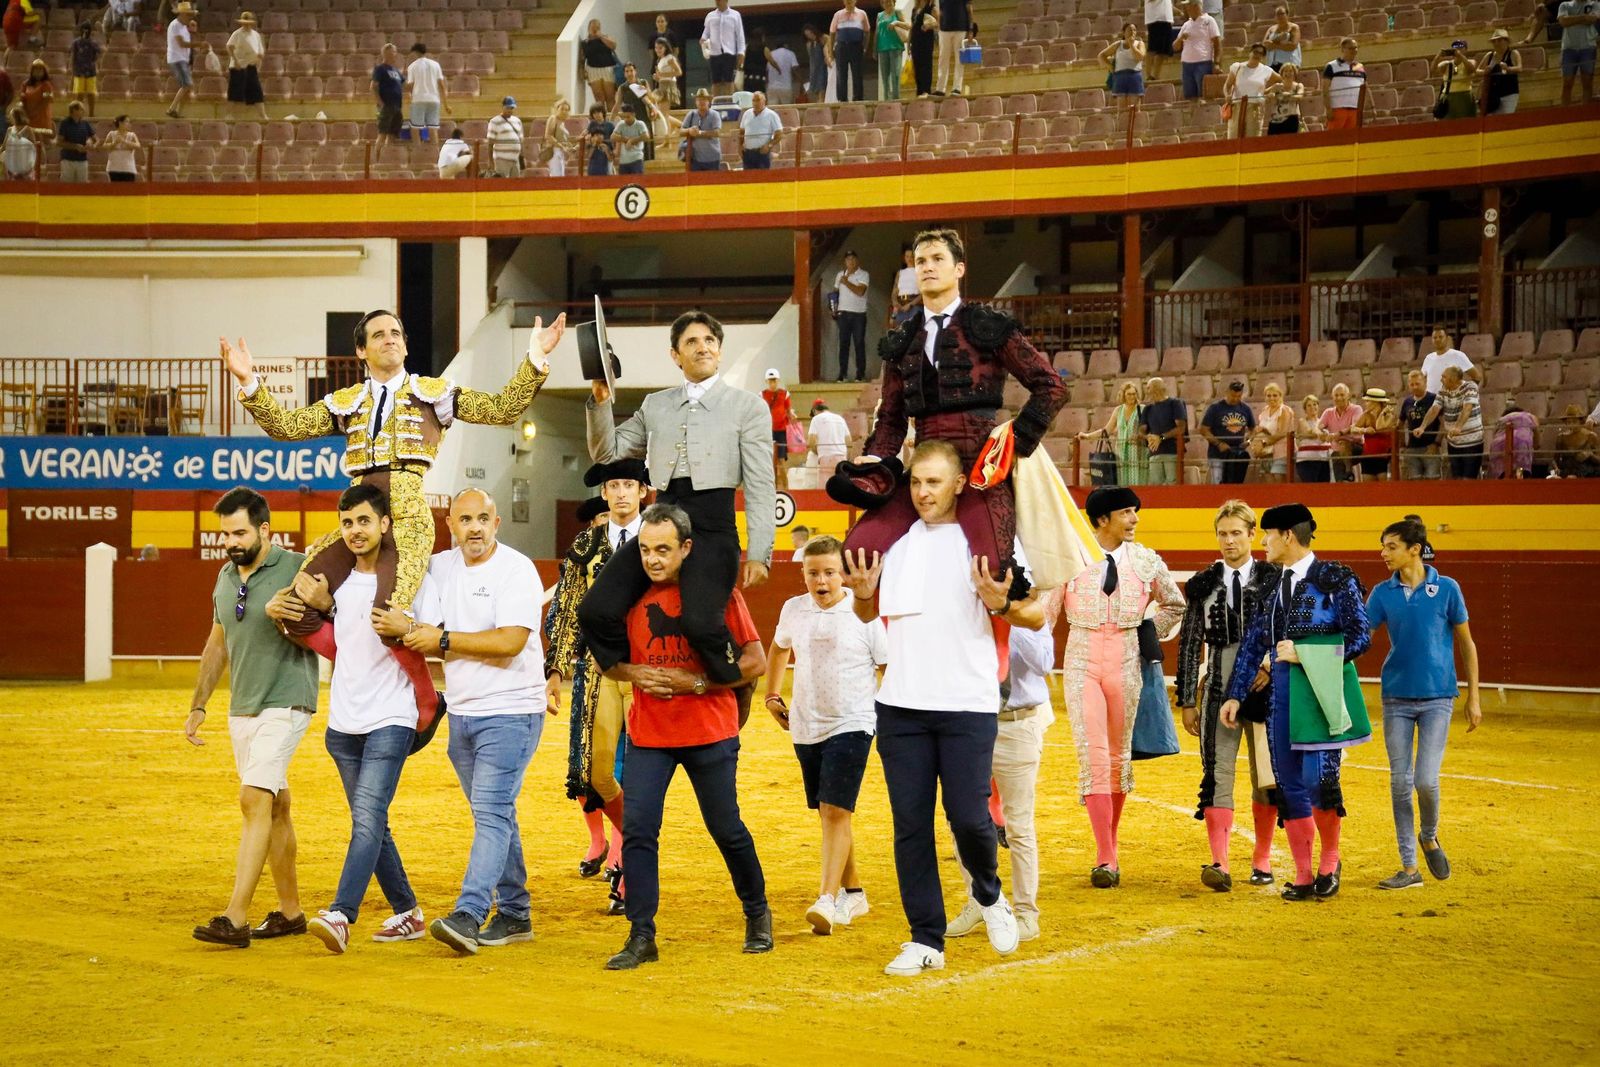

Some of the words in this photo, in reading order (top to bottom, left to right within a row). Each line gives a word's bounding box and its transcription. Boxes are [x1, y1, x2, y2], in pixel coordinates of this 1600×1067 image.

[624, 191, 639, 214] 6
[251, 364, 293, 373] ARINES
[266, 385, 294, 393] ALES
[173, 455, 205, 479] de
[20, 505, 118, 520] TORILES
[775, 498, 786, 520] 6
[200, 532, 296, 547] MAAL
